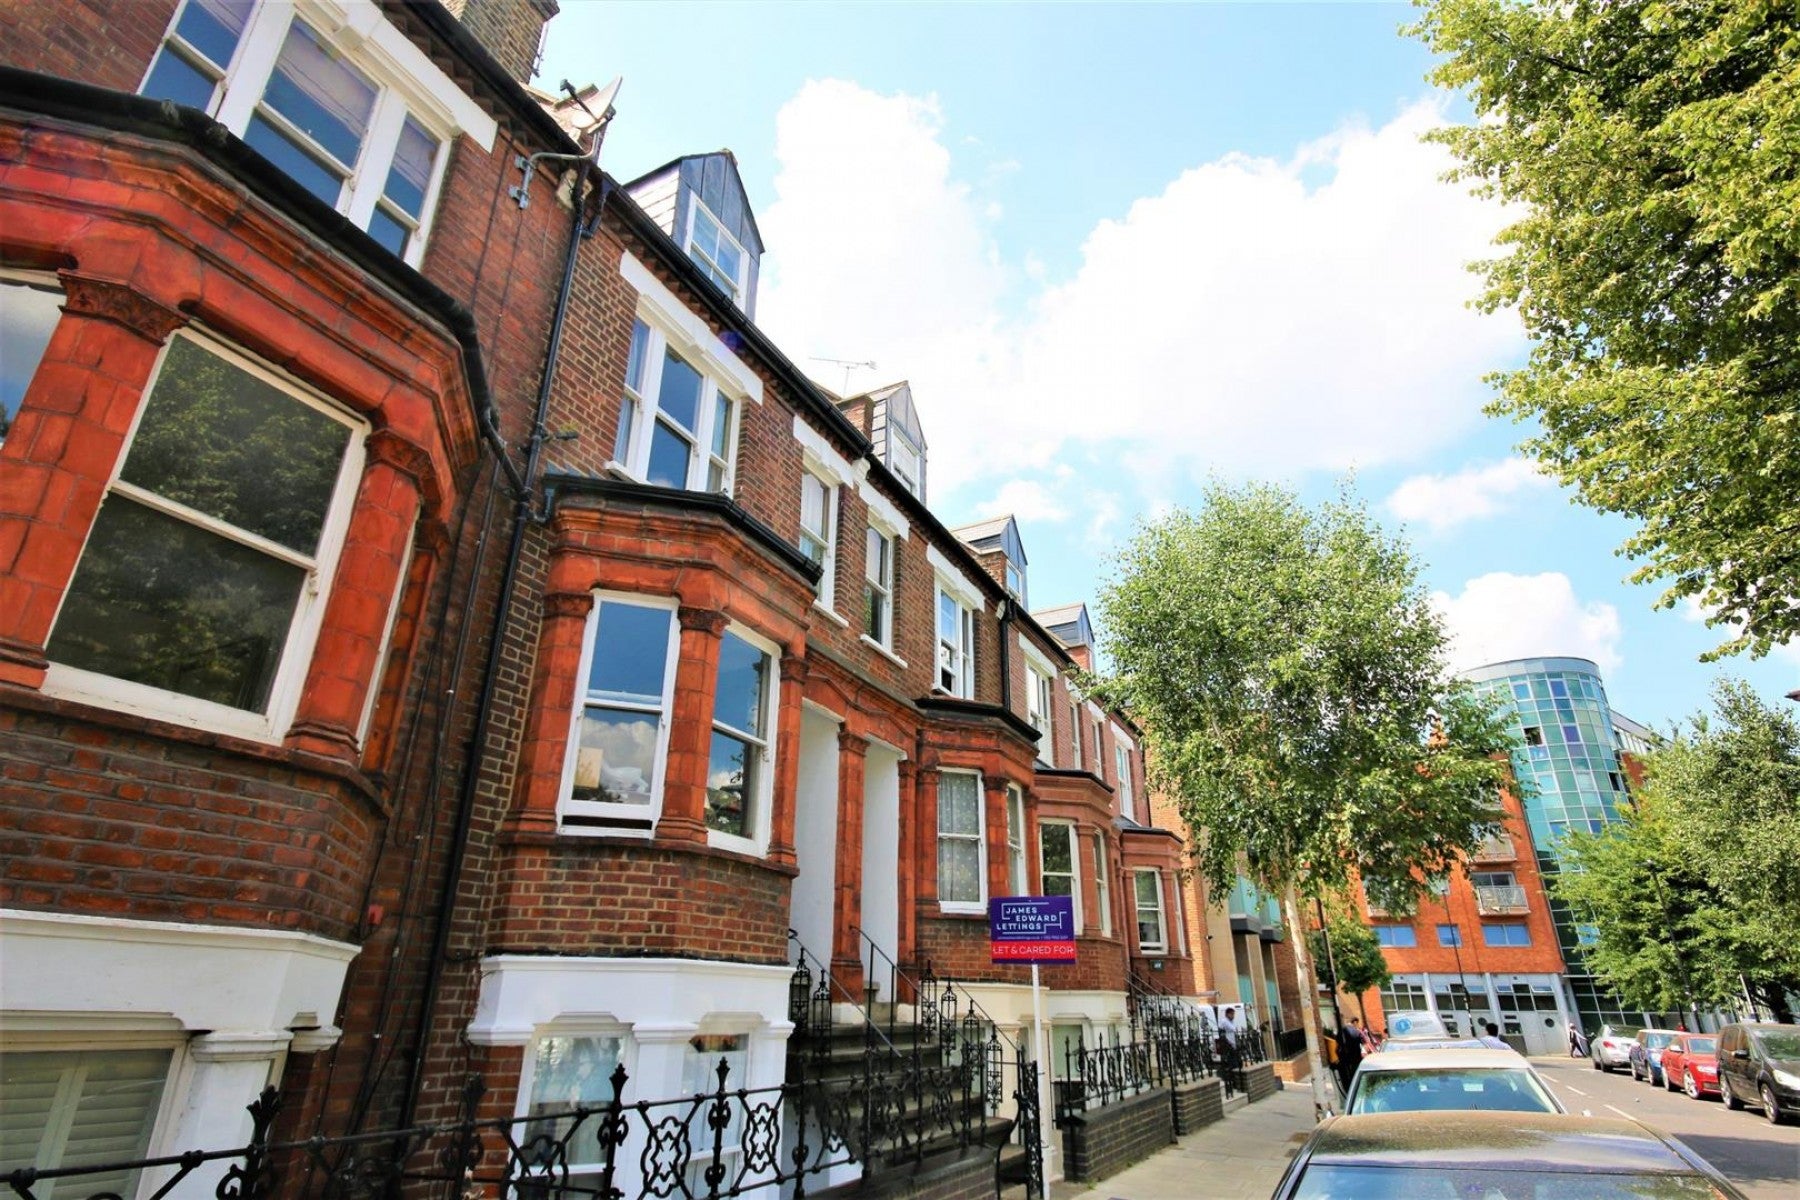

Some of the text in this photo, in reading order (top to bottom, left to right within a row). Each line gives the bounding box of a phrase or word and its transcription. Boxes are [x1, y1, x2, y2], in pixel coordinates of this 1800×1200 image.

[993, 946, 1010, 954] LET
[1019, 946, 1051, 954] CARED
[1053, 946, 1074, 954] FOR
